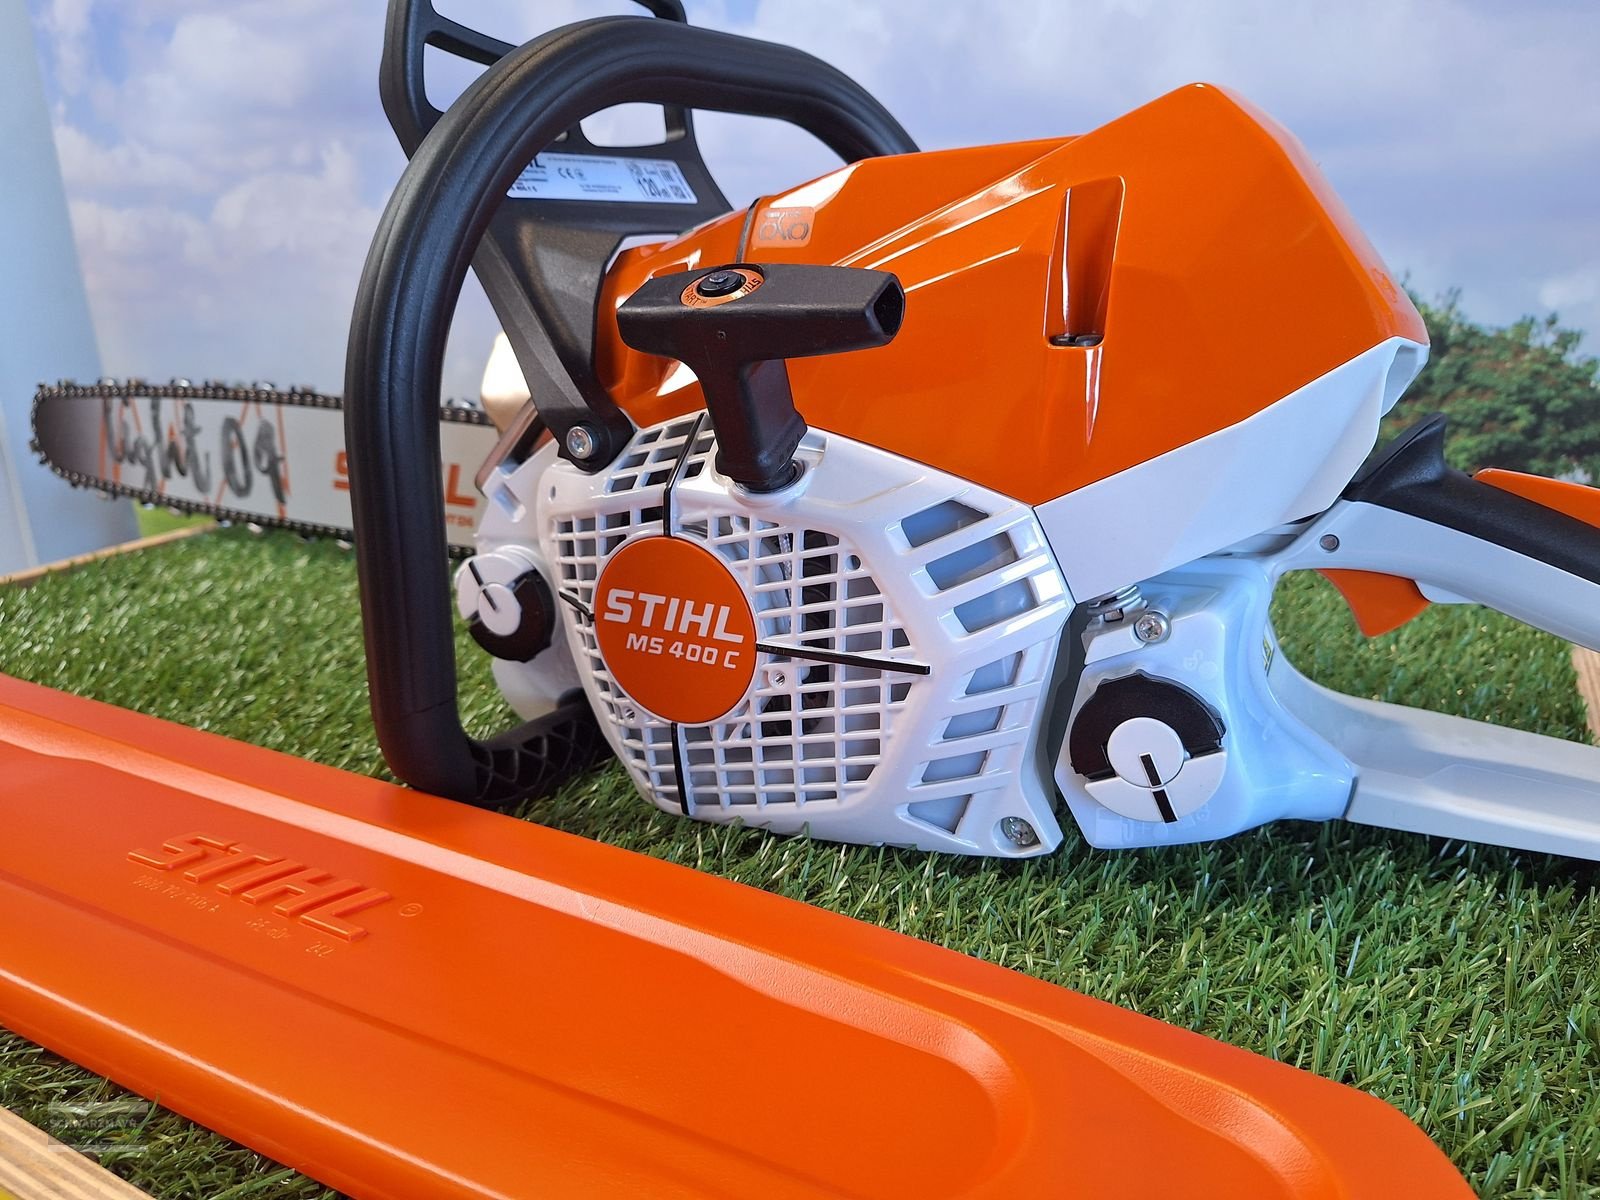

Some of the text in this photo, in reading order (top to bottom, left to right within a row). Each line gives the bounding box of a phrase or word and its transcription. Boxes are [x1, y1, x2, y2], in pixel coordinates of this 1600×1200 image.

[603, 588, 744, 644] STIHL
[626, 632, 740, 669] MS 400 C
[126, 831, 393, 943] STIHL
